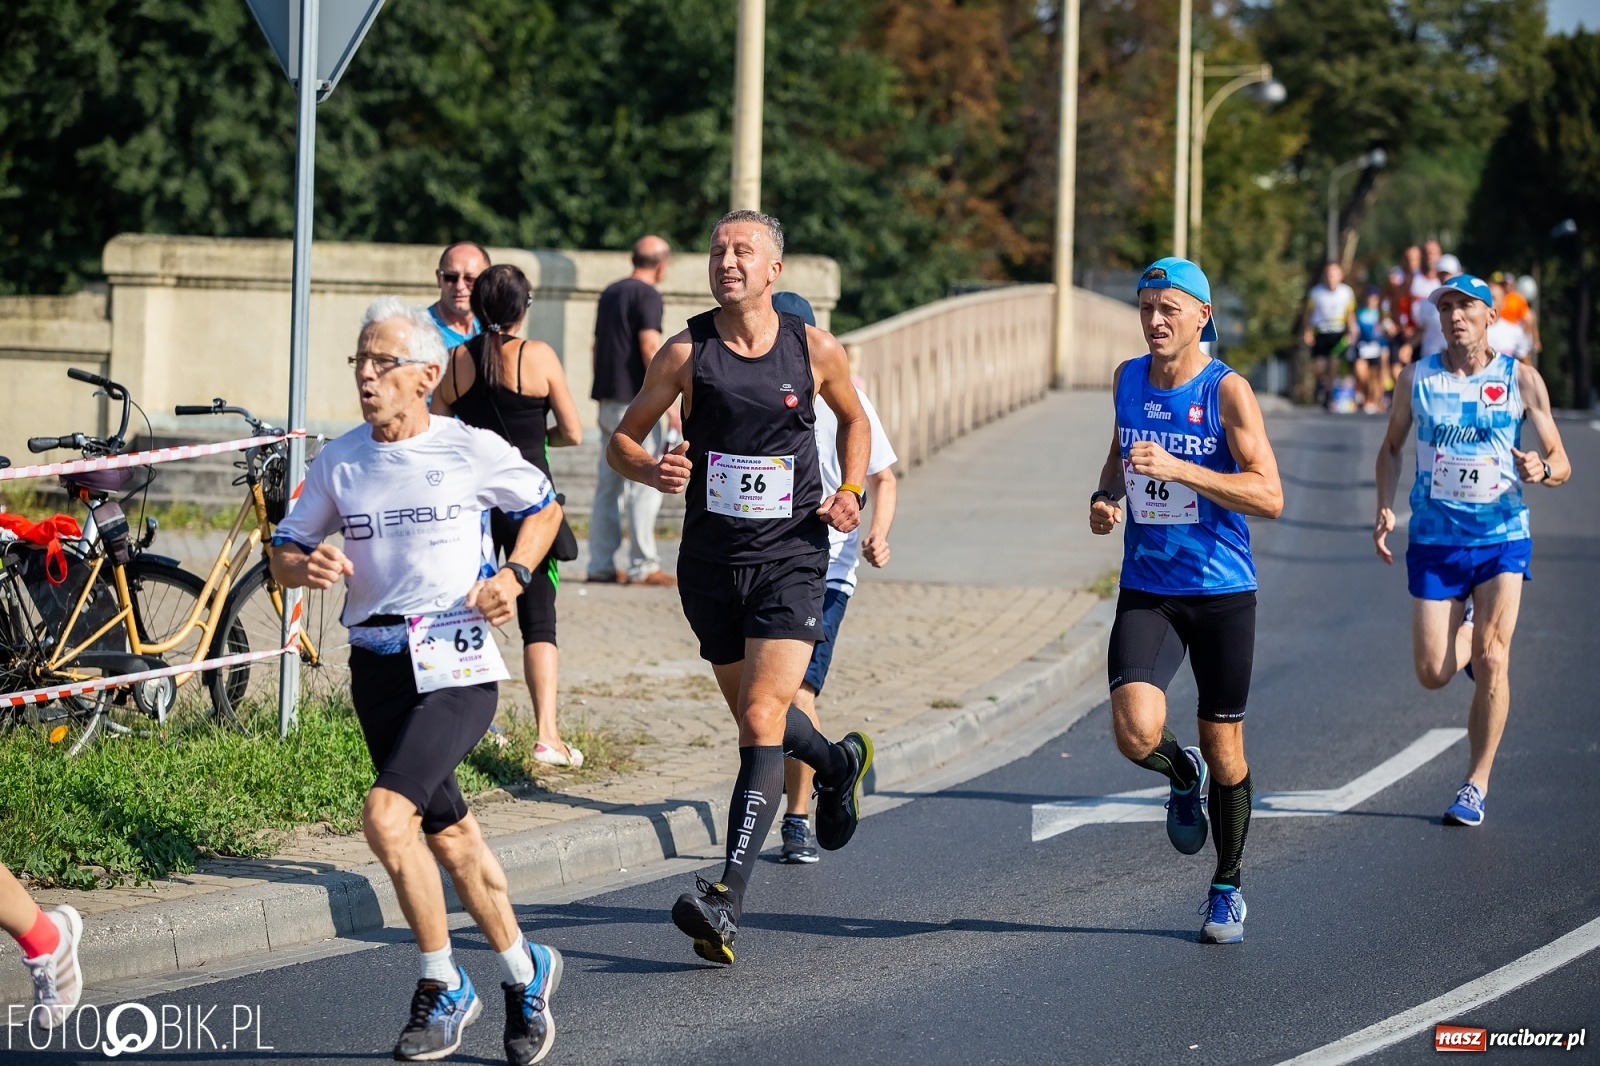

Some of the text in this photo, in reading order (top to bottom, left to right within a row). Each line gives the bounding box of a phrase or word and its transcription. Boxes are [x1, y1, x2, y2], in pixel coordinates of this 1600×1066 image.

[740, 473, 767, 494] 56
[1459, 468, 1479, 484] 74
[1144, 479, 1170, 501] 46
[454, 625, 485, 653] 63
